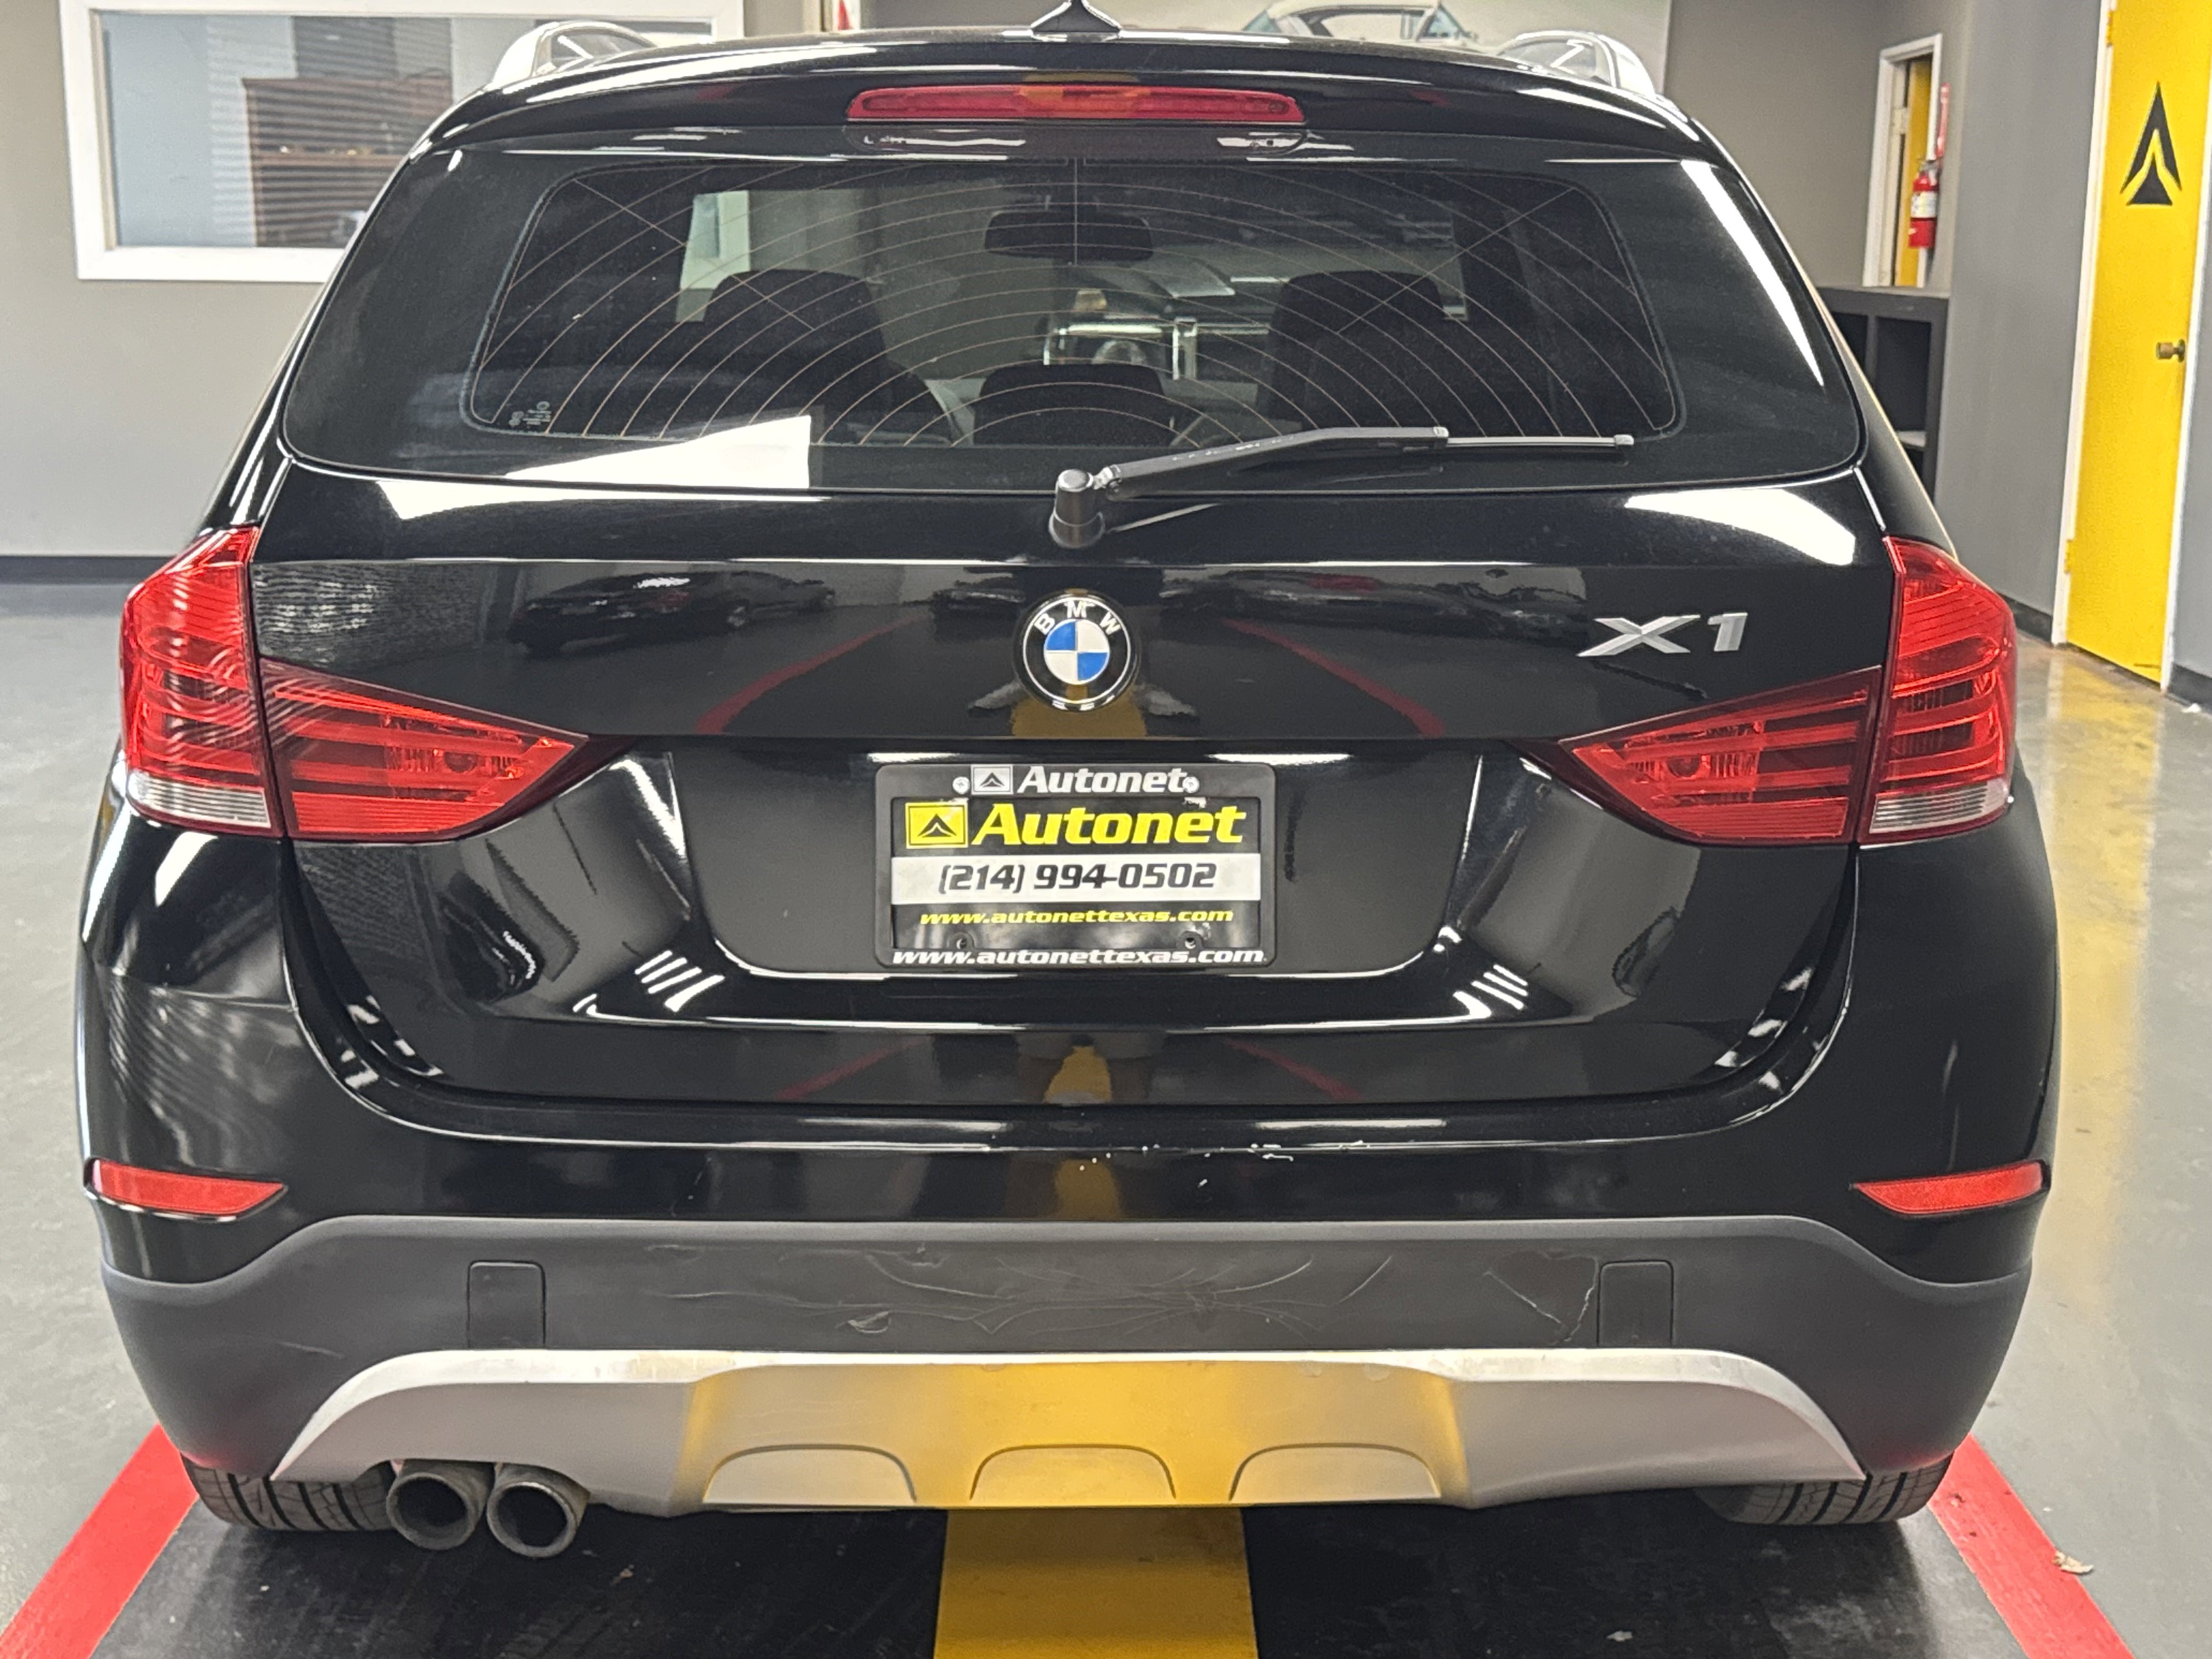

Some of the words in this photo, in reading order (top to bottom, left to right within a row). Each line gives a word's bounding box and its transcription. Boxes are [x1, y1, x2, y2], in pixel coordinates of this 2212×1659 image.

[1034, 600, 1121, 635] BMW
[1576, 612, 1748, 657] X1
[1017, 766, 1188, 793] Autonet
[972, 803, 1246, 845] Autonet
[938, 864, 1025, 894] (214)
[1034, 862, 1217, 890] 994-0502
[920, 910, 1233, 924] www.autonettexas.com
[893, 950, 1264, 964] www.autonettexas.com
